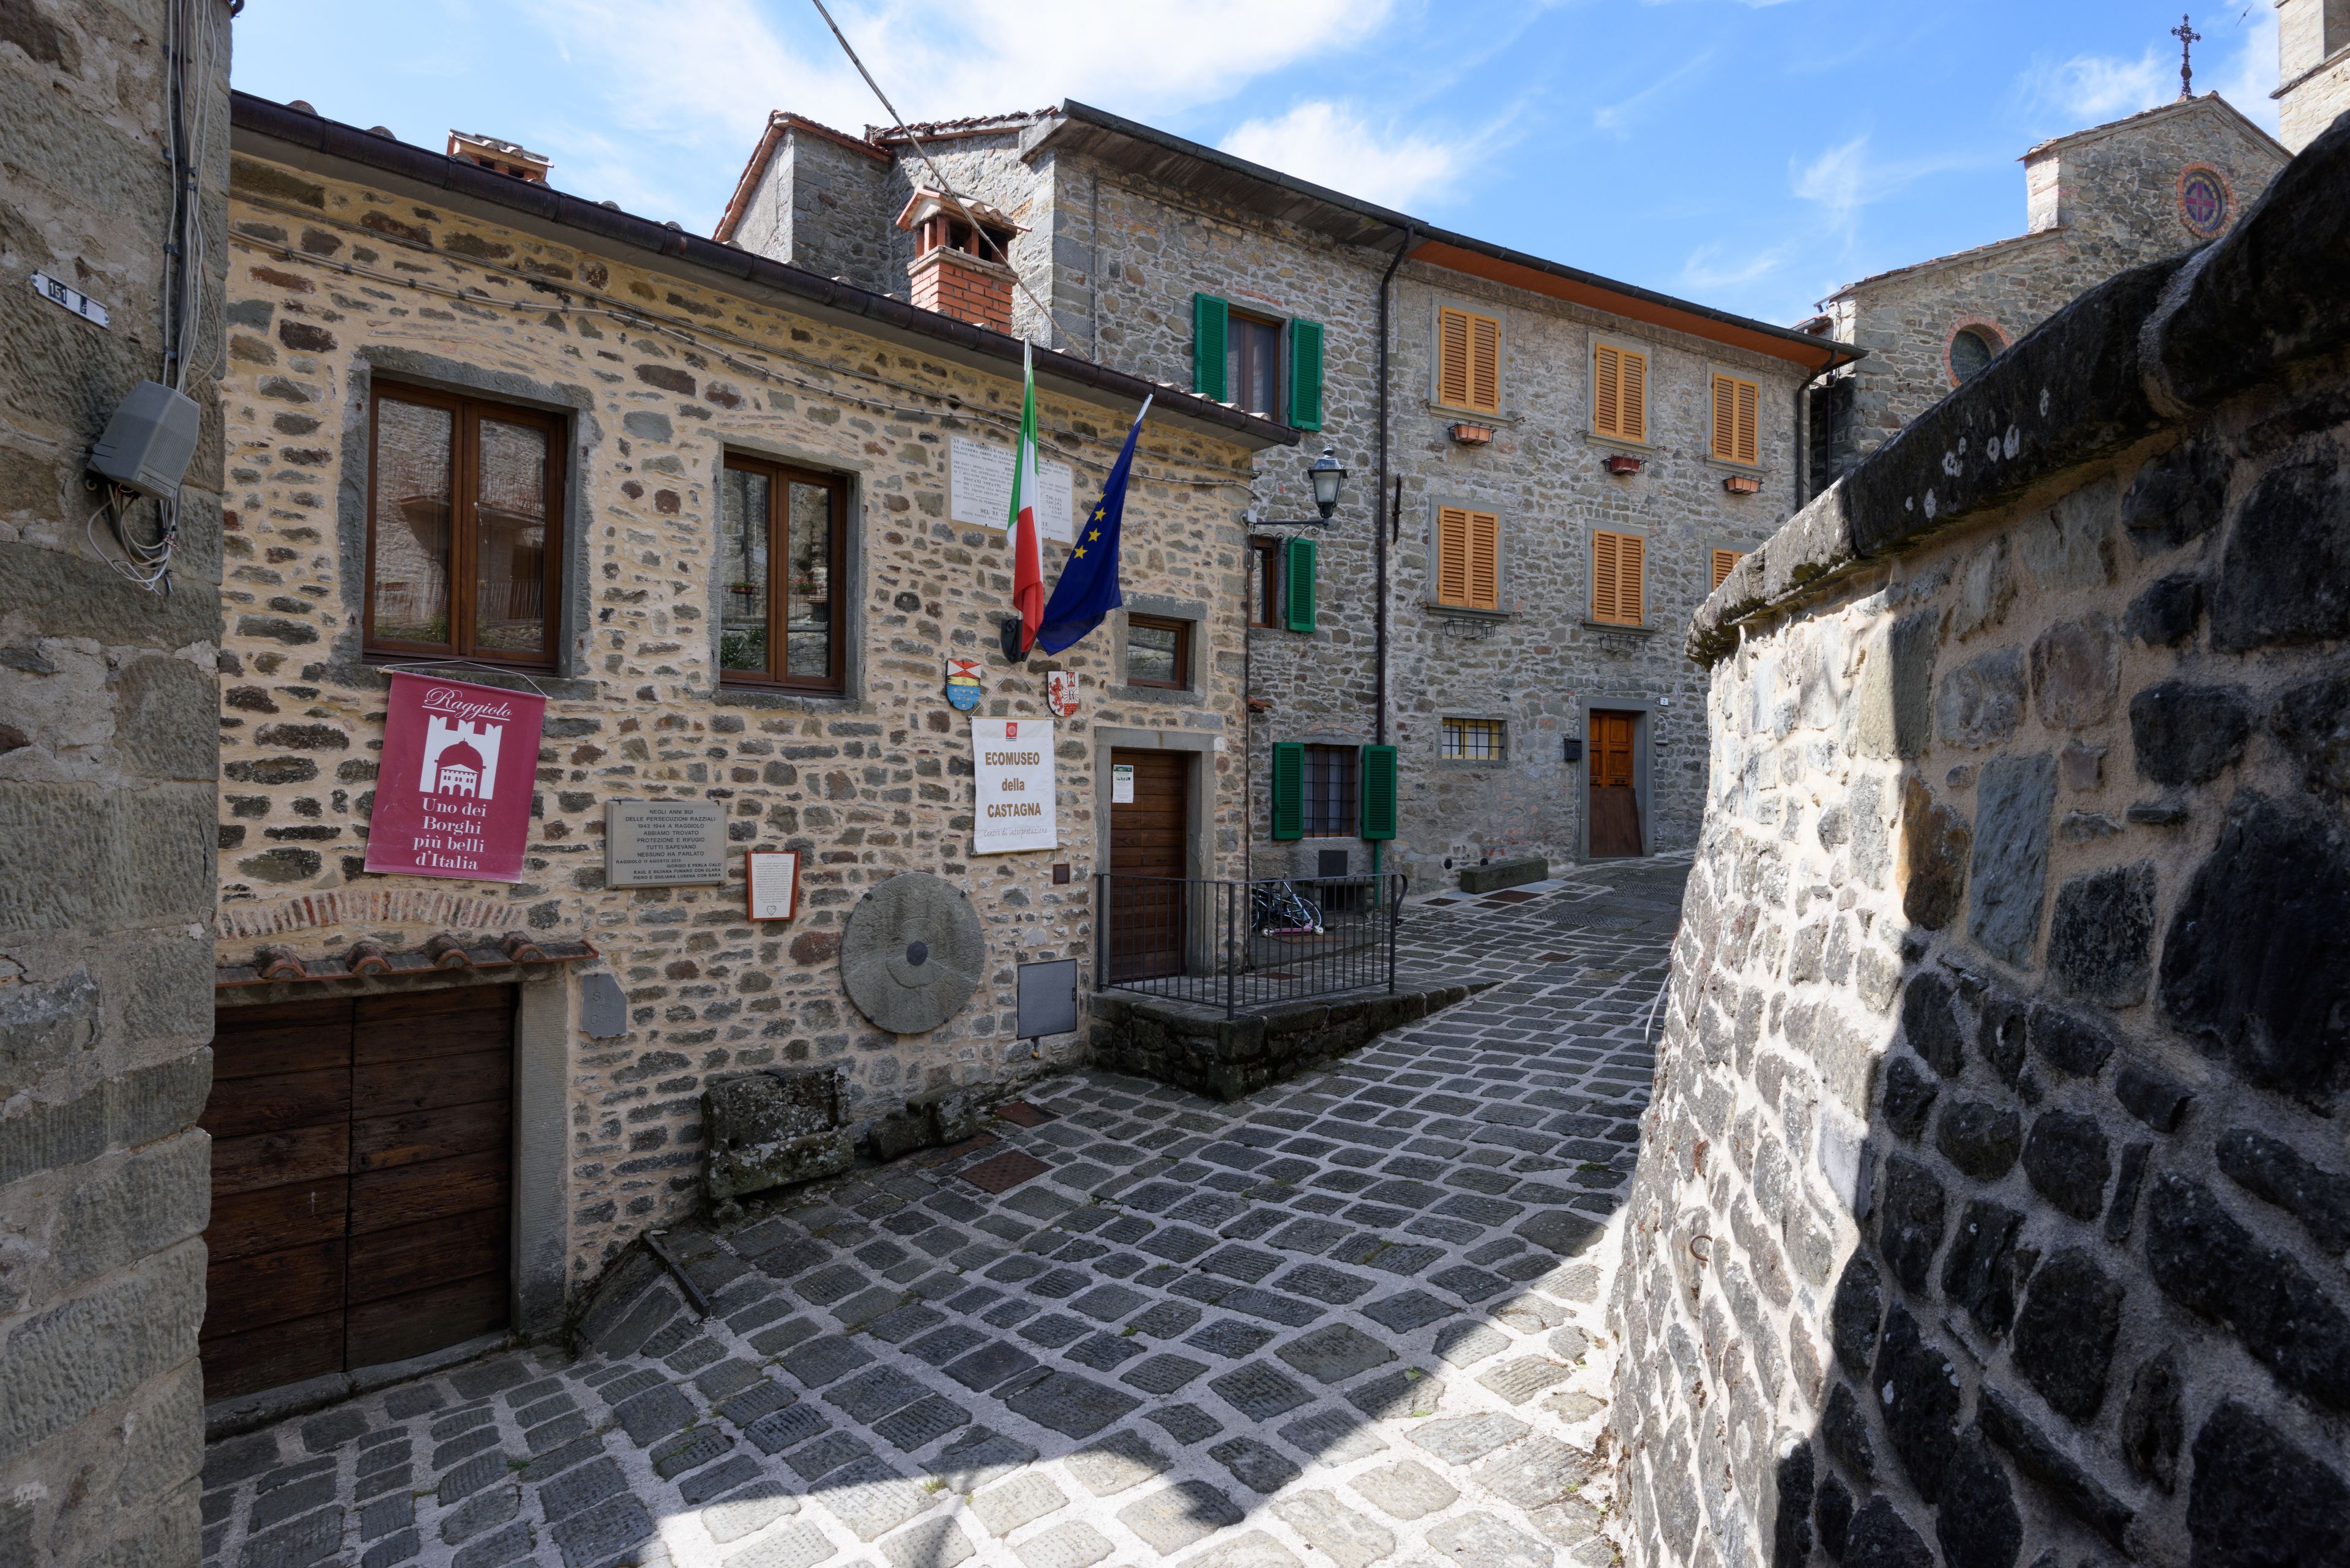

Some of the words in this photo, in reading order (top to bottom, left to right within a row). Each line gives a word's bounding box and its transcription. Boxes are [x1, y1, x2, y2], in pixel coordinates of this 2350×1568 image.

[50, 282, 66, 301] 151
[424, 687, 513, 720] Raggiolo
[985, 752, 1040, 766] ECOMUSEO
[1002, 778, 1024, 791] della
[422, 797, 457, 813] Uno
[462, 802, 487, 817] dei
[987, 803, 1042, 818] CASTAGNA
[421, 816, 481, 836] Borghi
[983, 829, 1001, 837] Centro
[1009, 826, 1048, 838] interpretazione
[412, 835, 441, 850] più
[447, 837, 484, 853] belli
[416, 851, 478, 870] d'Italia
[593, 991, 617, 1001] SALA
